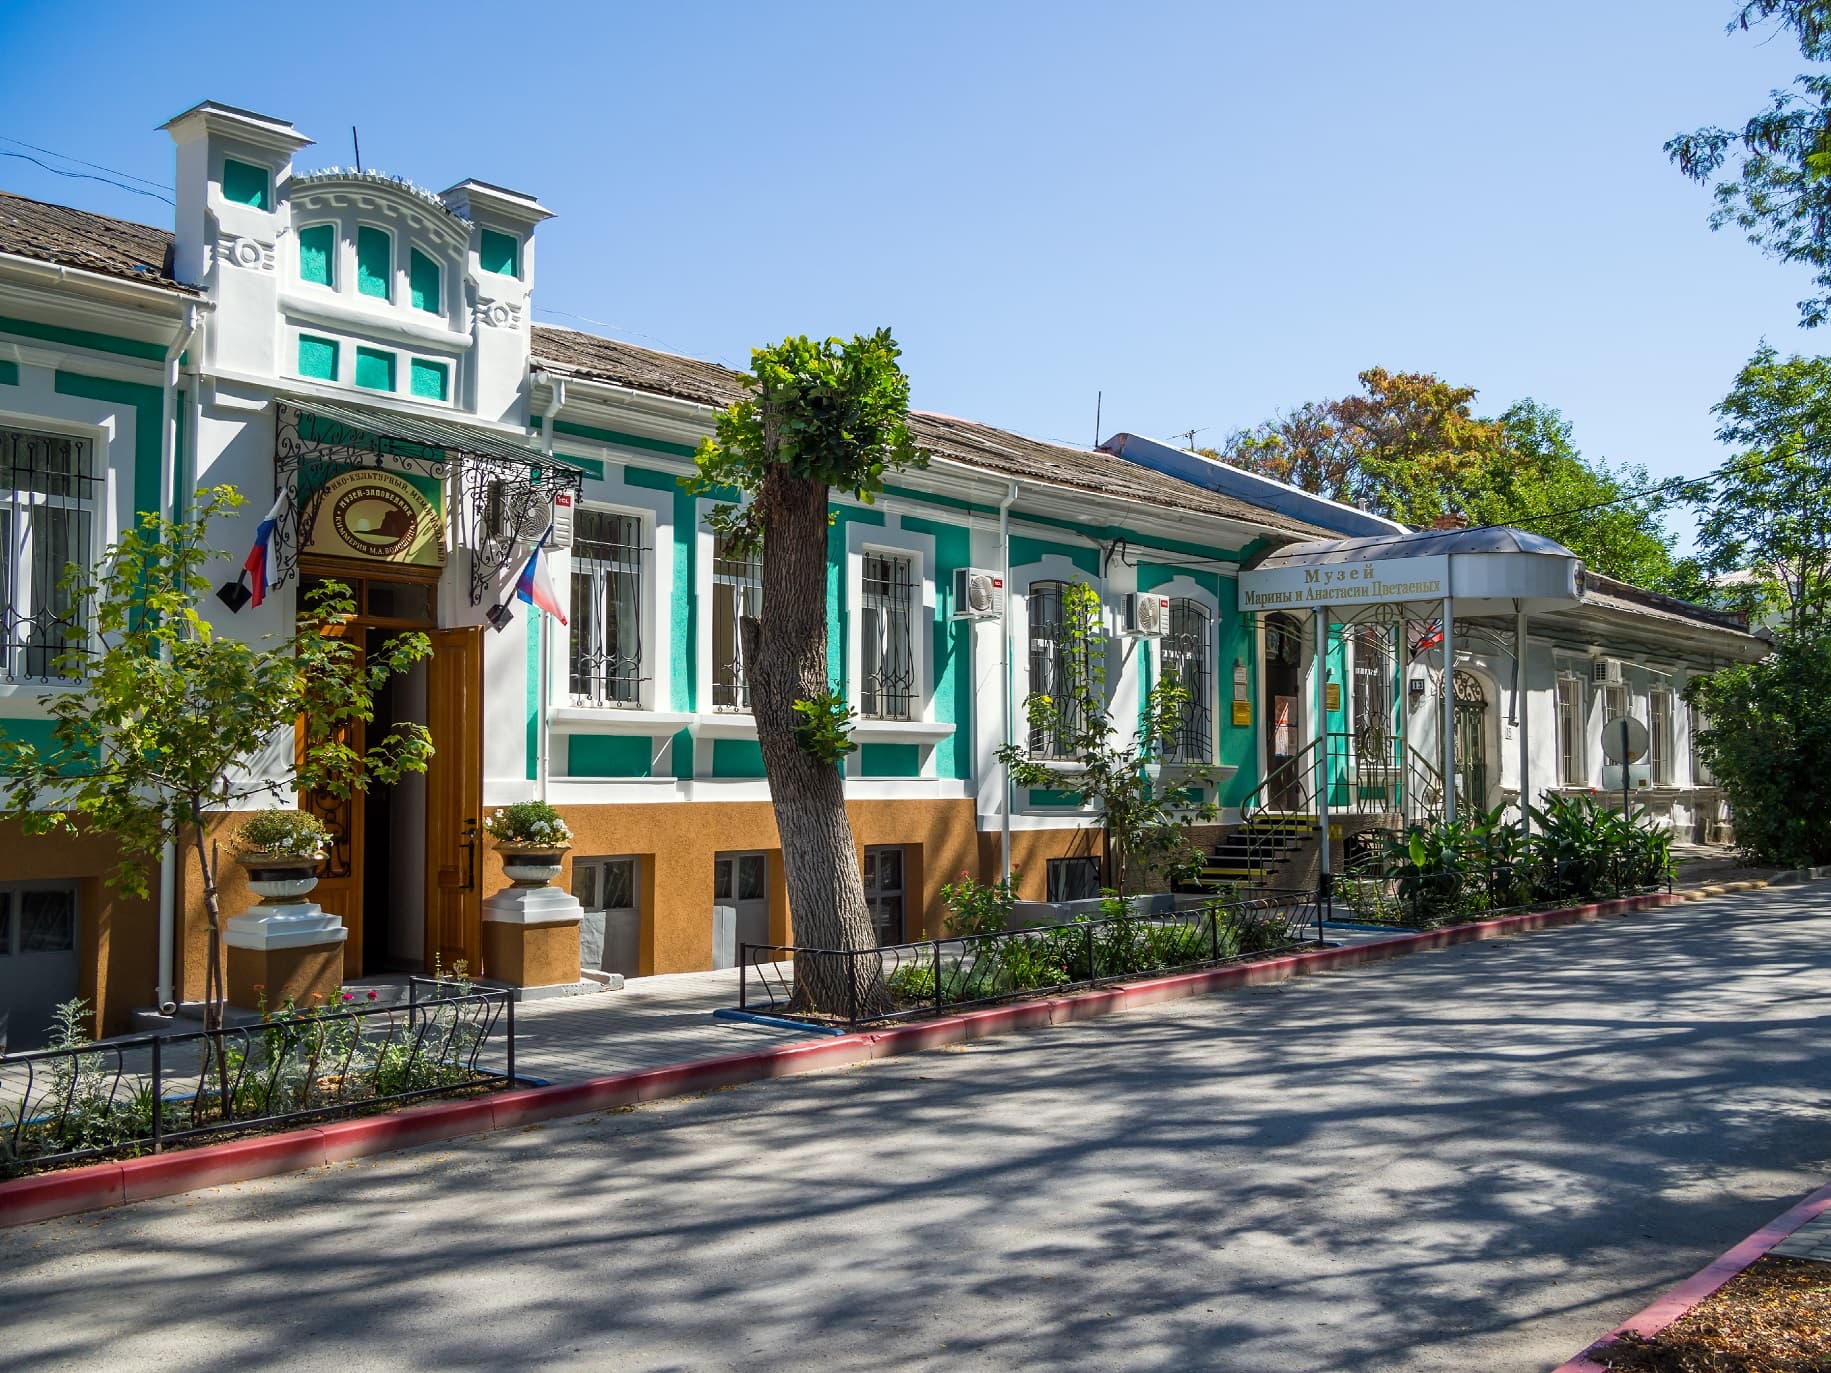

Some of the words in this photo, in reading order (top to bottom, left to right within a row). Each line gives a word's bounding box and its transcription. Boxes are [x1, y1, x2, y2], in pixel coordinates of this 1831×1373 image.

[1304, 563, 1375, 585] Музей
[1244, 590, 1293, 608] Марины
[1295, 591, 1304, 601] и
[1306, 586, 1369, 601] Анастасии
[1371, 580, 1440, 598] Цветаевых
